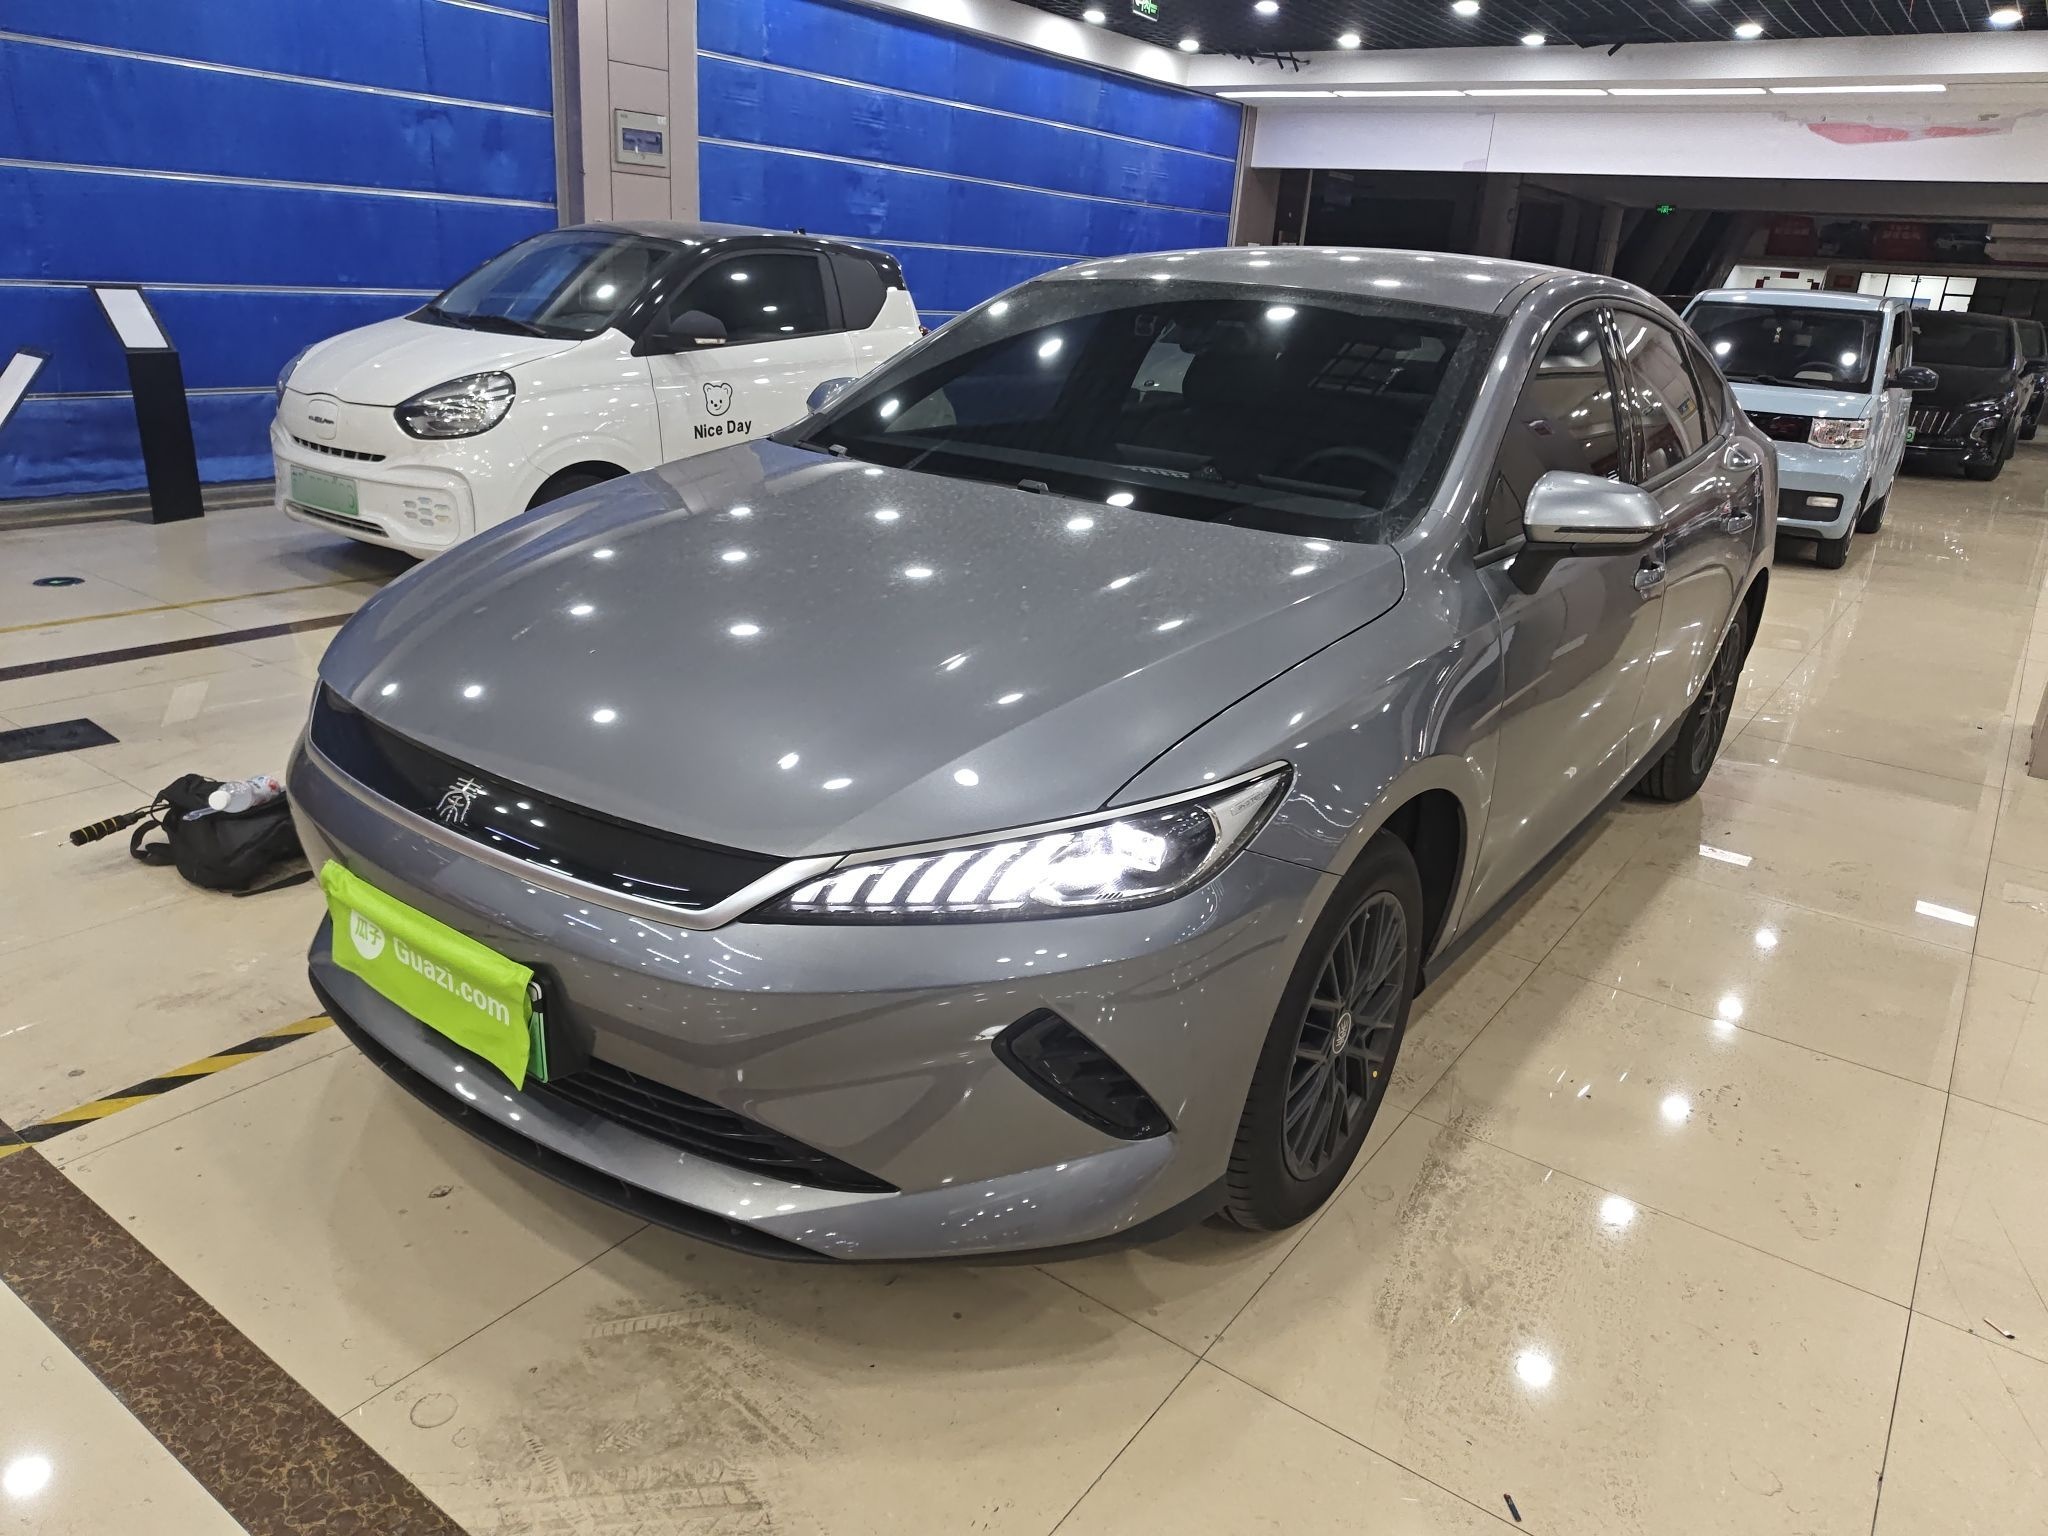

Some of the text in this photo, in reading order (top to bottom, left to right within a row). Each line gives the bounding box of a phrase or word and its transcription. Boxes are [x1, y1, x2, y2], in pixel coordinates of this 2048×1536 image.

[694, 420, 752, 440] Nice Day
[355, 916, 382, 946] 瓜子
[393, 936, 510, 1026] Guazi.com
